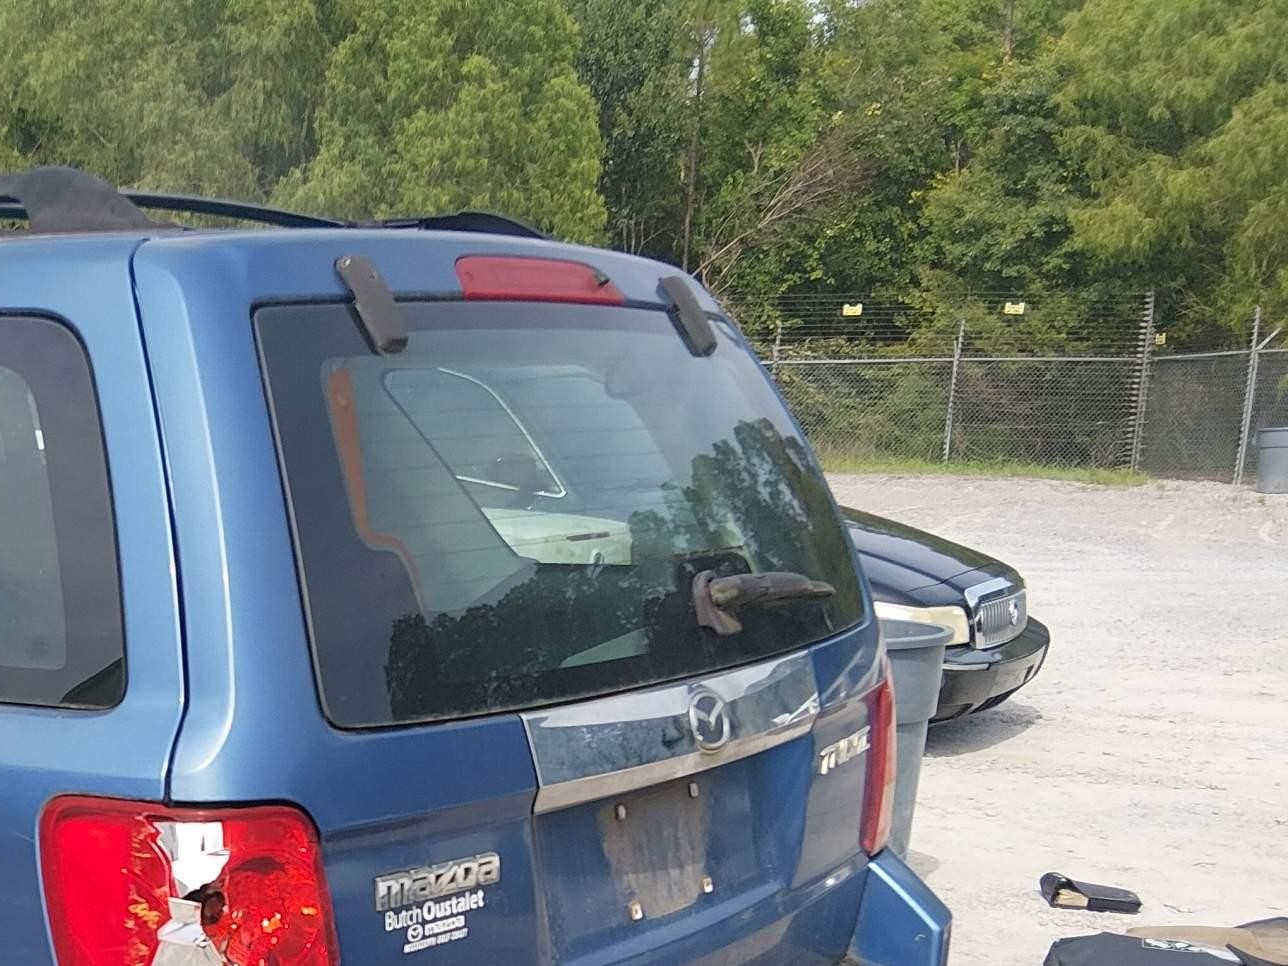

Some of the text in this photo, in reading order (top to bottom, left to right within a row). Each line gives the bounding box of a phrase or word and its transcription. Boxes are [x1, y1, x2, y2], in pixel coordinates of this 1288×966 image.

[375, 852, 500, 911] mazda
[385, 907, 422, 931] Butch
[423, 889, 485, 920] Oustalet
